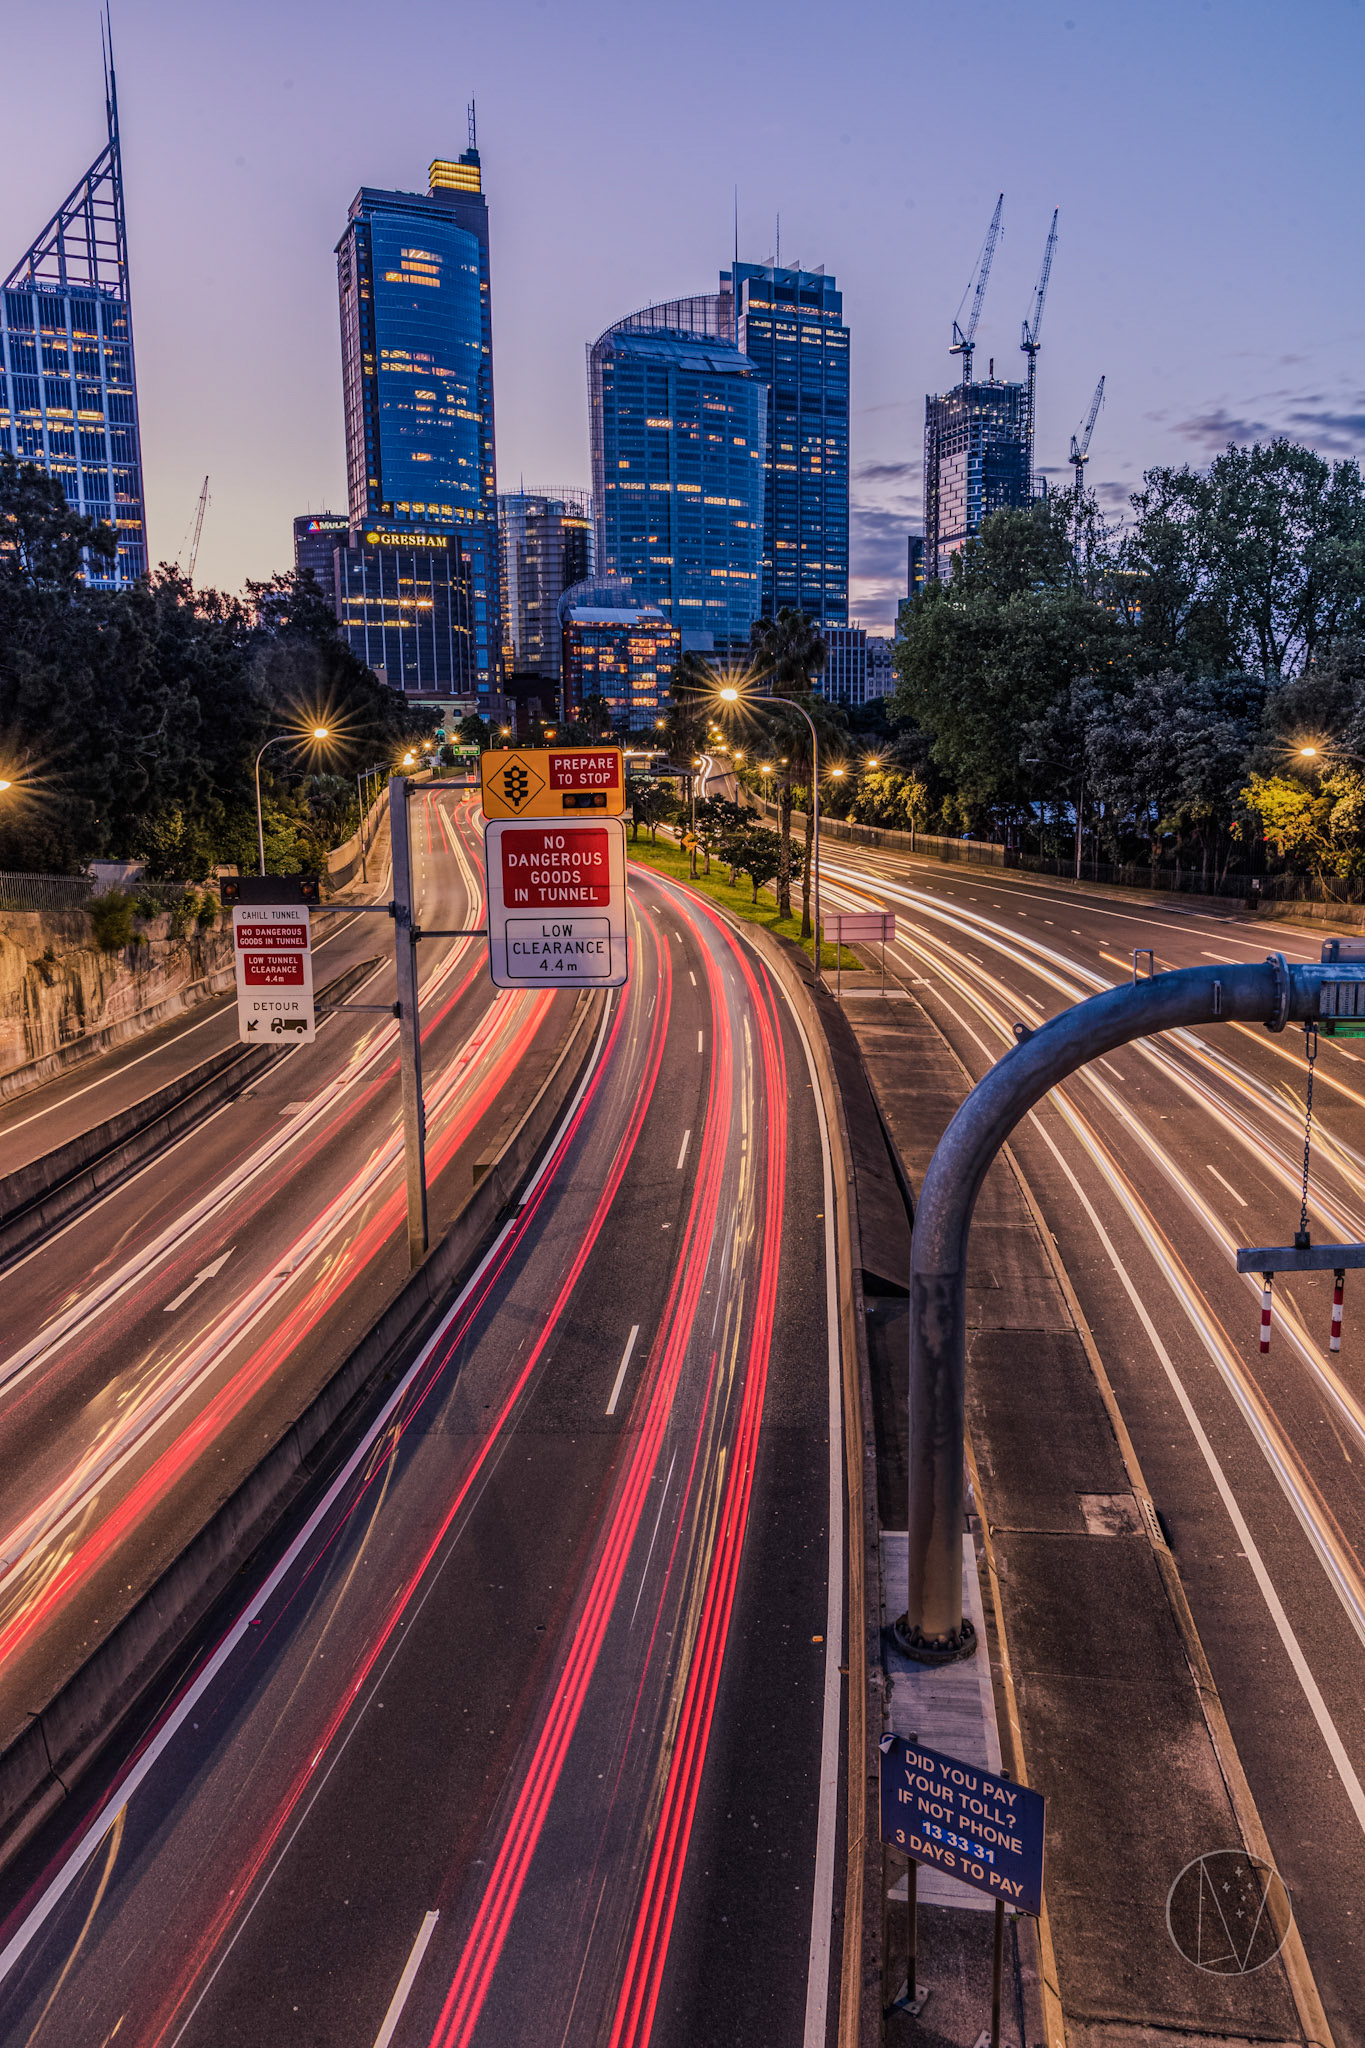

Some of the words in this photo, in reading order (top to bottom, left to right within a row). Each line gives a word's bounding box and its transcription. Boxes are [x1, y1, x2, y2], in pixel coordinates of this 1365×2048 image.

[381, 534, 447, 547] GRESHAM
[555, 758, 614, 770] PREPARE
[558, 773, 573, 785] TO
[580, 772, 611, 784] STOP
[544, 836, 565, 849] NO
[508, 852, 602, 867] DANGEROUS
[531, 870, 581, 884] GOODS
[514, 888, 529, 901] IN
[539, 887, 598, 901] TUNNEL
[241, 911, 268, 920] CAHILL
[272, 911, 300, 919] TUNNEL
[241, 928, 252, 936] NO
[255, 928, 302, 936] DANGEROUS
[542, 924, 573, 937] LOW
[240, 937, 263, 945] GOODS
[513, 941, 604, 955] CLEARANCE
[248, 956, 265, 964] LOW
[267, 956, 299, 964] TUNNEL
[251, 966, 297, 974] CLEARANCE
[253, 1002, 299, 1011] DETOUR
[905, 1749, 935, 1773] DID
[939, 1763, 977, 1791] YOU
[983, 1781, 1017, 1807] PAY
[904, 1769, 953, 1803] YOUR
[958, 1792, 1017, 1829] TOLL?
[898, 1788, 914, 1804] IF
[917, 1797, 954, 1824] NOT
[959, 1814, 1023, 1855] PHONE
[922, 1821, 943, 1840] 13
[947, 1831, 969, 1852] 33
[974, 1844, 995, 1864] 31
[896, 1829, 906, 1844] 3
[910, 1834, 956, 1868] DAYS
[960, 1857, 984, 1880] TO
[989, 1871, 1024, 1897] PAY
